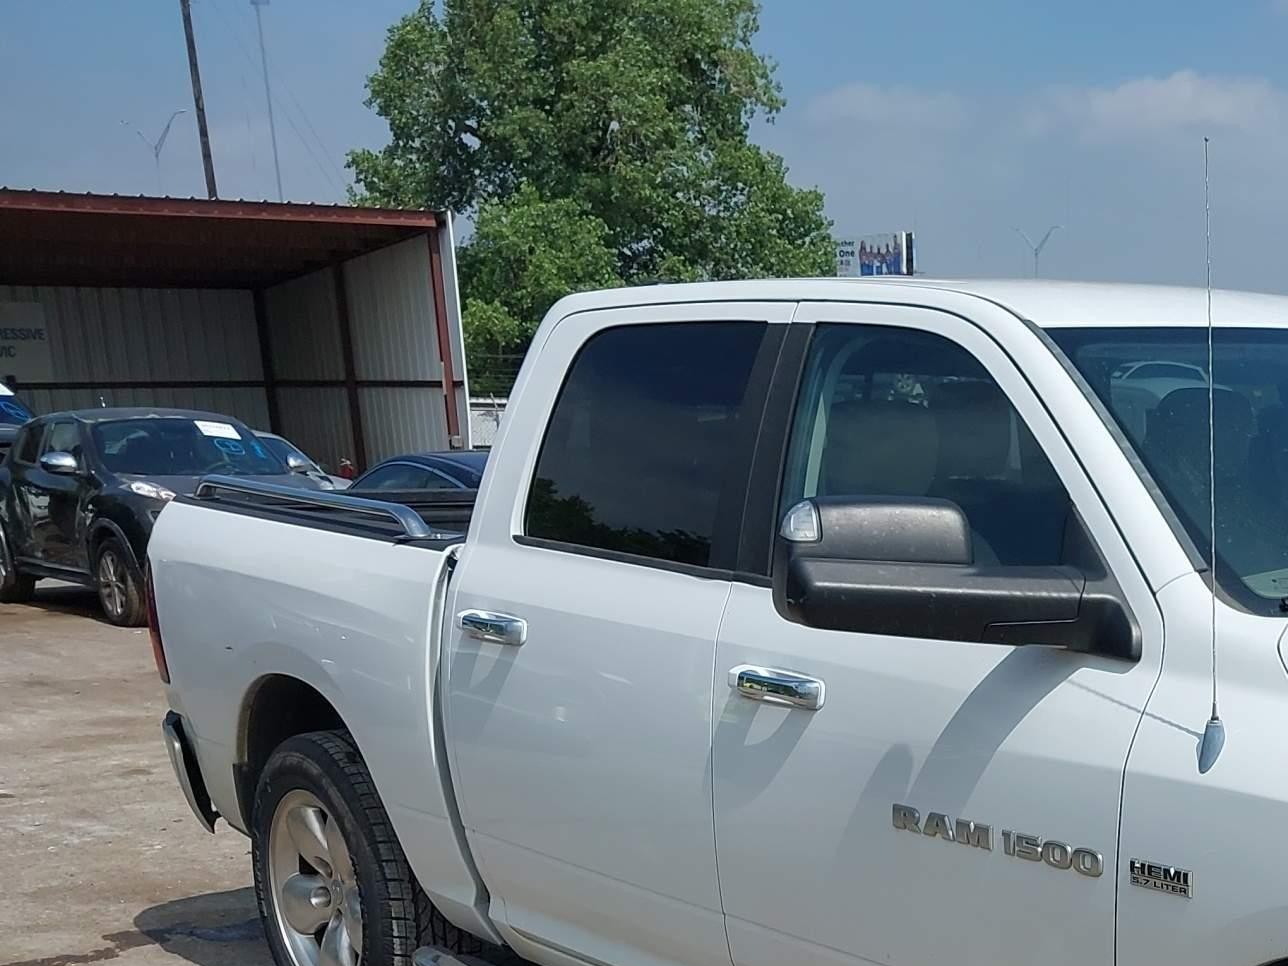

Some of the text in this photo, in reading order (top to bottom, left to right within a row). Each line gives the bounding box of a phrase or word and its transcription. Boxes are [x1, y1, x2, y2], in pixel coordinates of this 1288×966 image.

[892, 803, 1104, 878] RAM 1500
[1129, 857, 1191, 886] HEMI
[1130, 875, 1188, 896] 5.7 LITER
